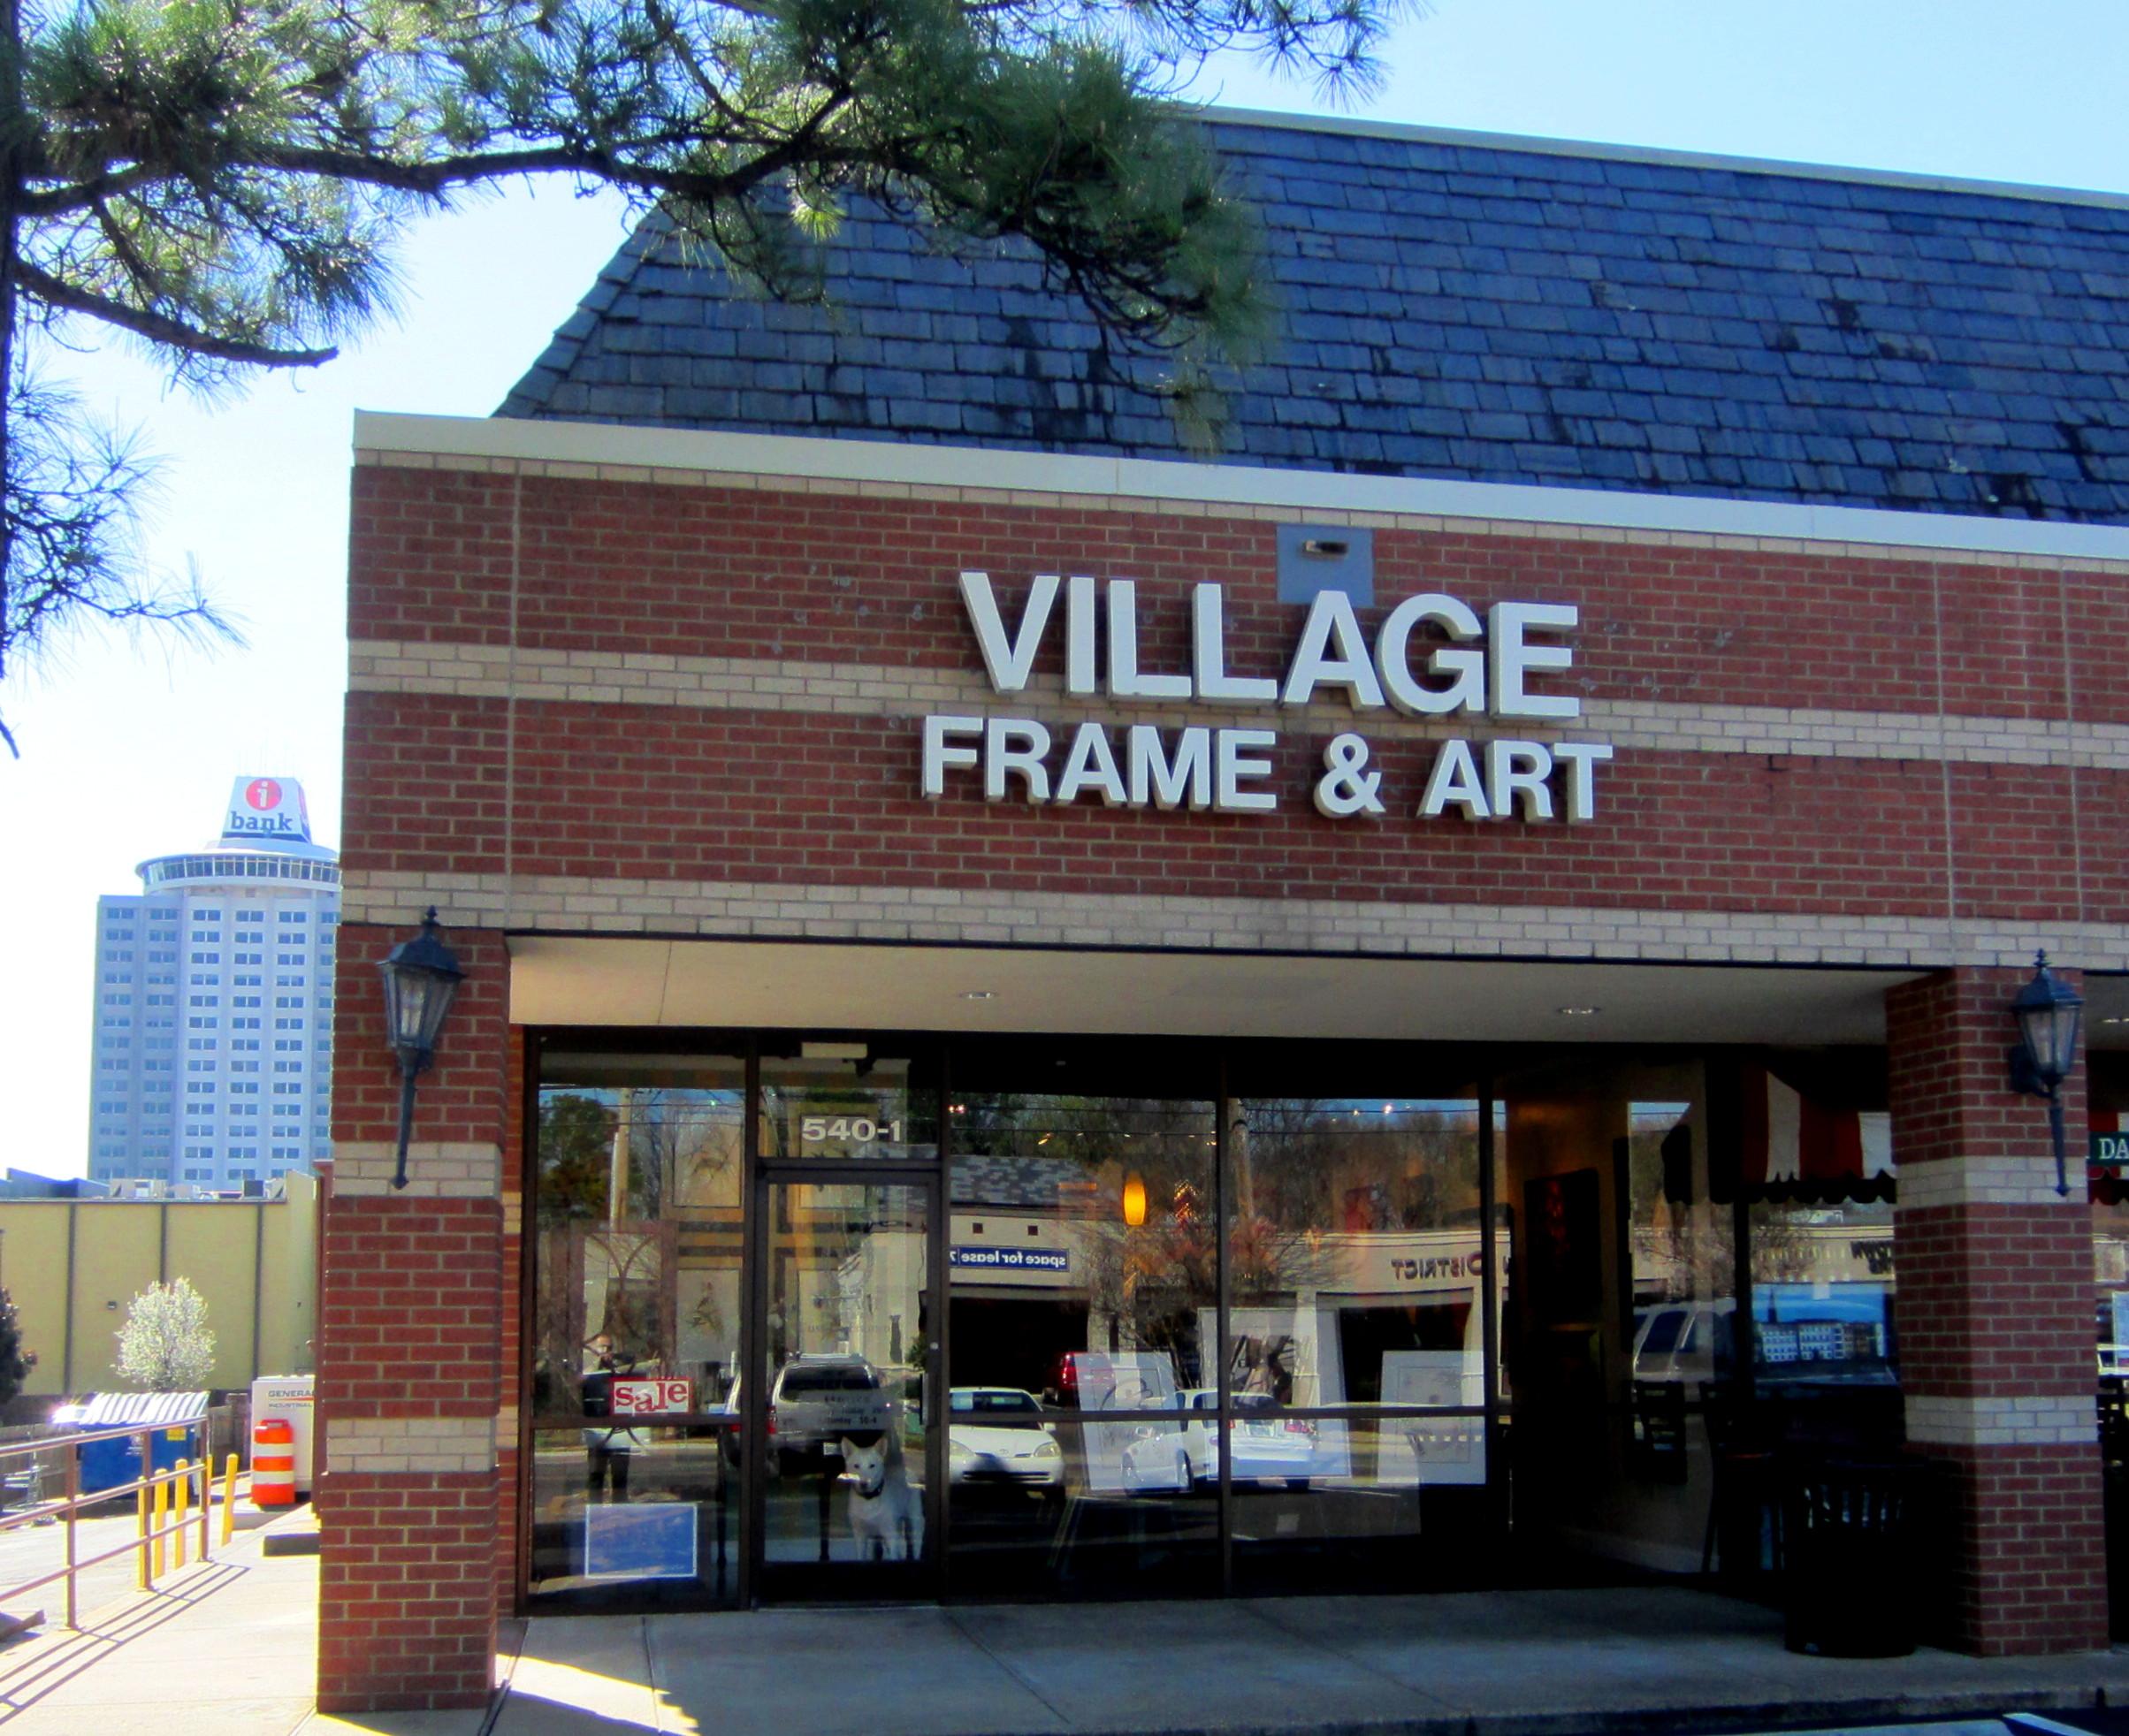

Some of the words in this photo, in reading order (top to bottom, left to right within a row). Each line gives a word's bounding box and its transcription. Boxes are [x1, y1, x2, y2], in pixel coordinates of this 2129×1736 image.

[958, 572, 1581, 720] VILLAGE
[922, 714, 1278, 814] FRAME
[1314, 733, 1386, 819] &
[1417, 739, 1614, 826] ART
[230, 811, 294, 831] bank
[802, 1118, 900, 1142] 540-1
[614, 1382, 688, 1412] sale
